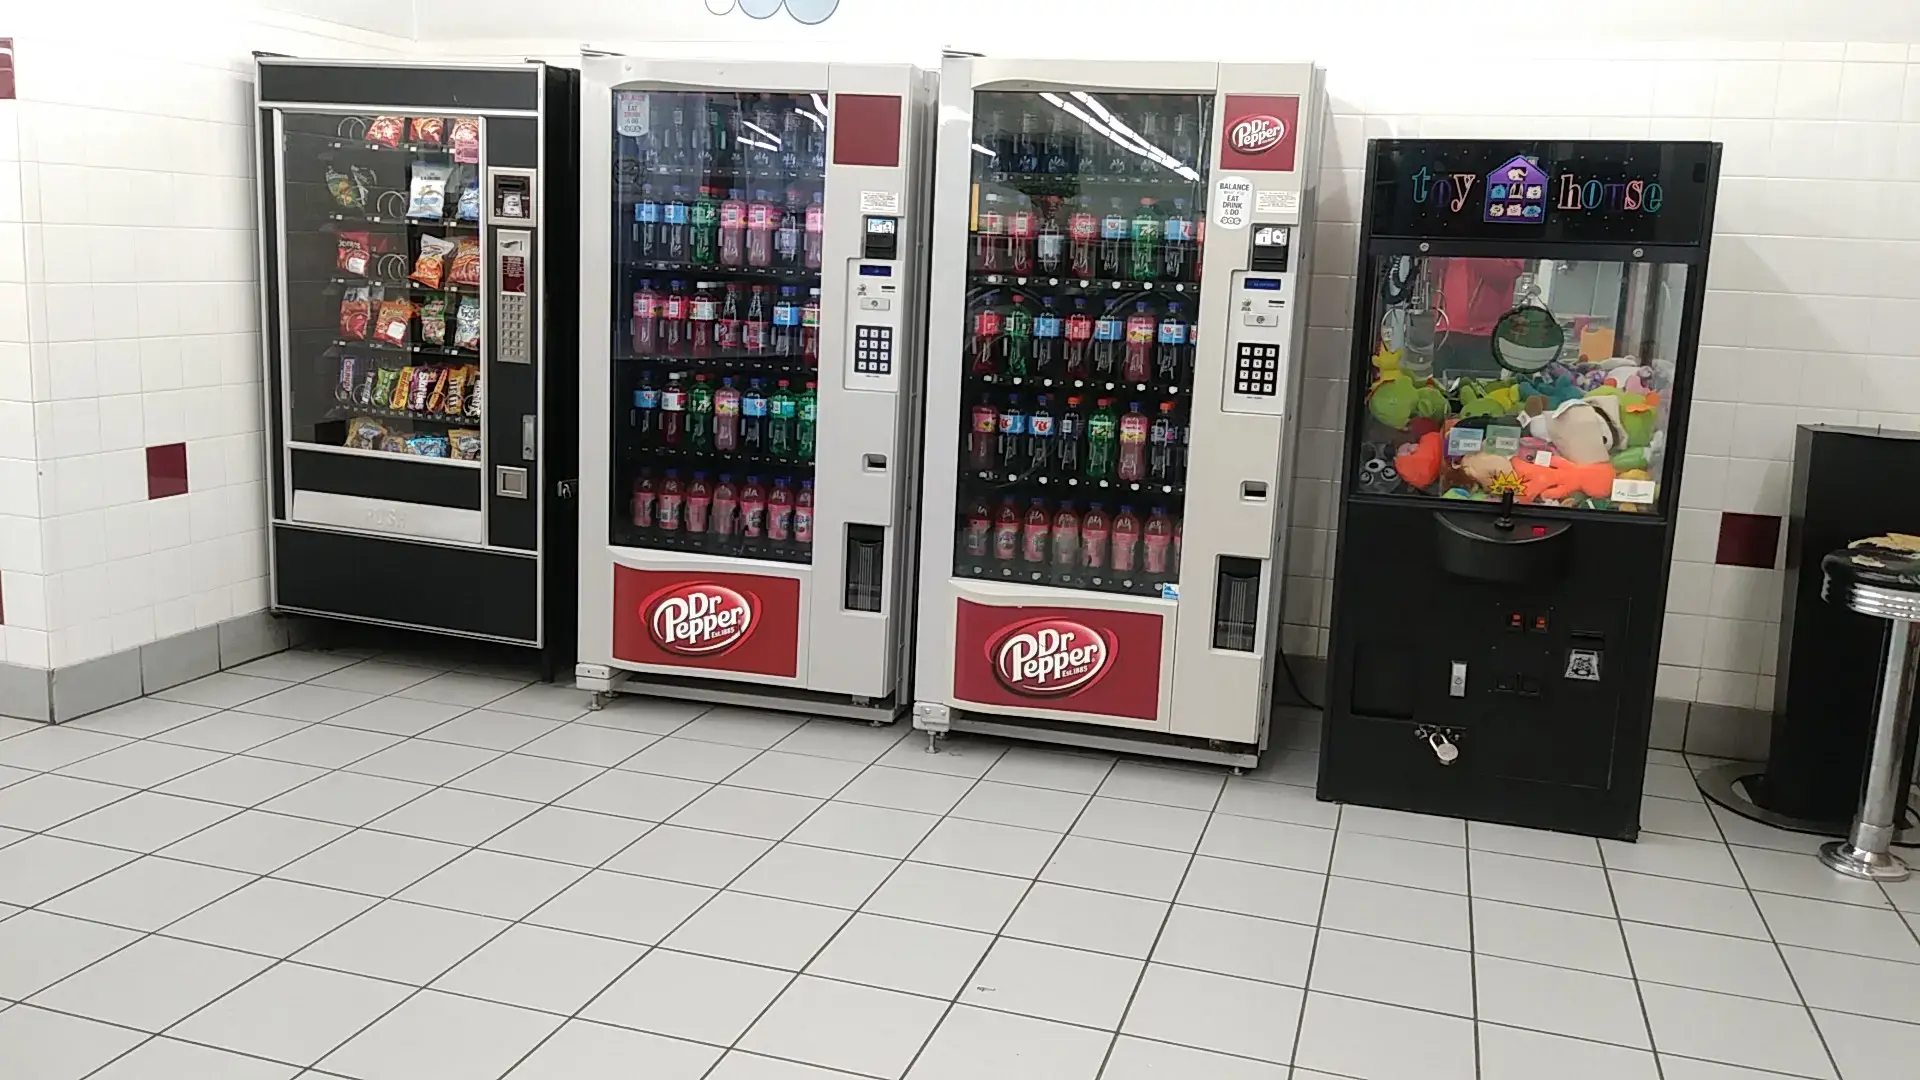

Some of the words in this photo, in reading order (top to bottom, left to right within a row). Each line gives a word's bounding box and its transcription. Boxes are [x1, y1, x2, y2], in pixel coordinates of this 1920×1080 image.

[1232, 122, 1280, 147] Pepper
[1251, 119, 1270, 133] Dr
[1219, 182, 1250, 192] BALANCE
[1226, 194, 1240, 202] EAT
[1411, 166, 1476, 213] toy
[1557, 173, 1663, 213] house
[1222, 202, 1243, 210] DRINK
[687, 592, 722, 620] Dr
[653, 597, 745, 645] Pepper
[1037, 628, 1075, 658] Dr
[999, 633, 1098, 684] Pepper
